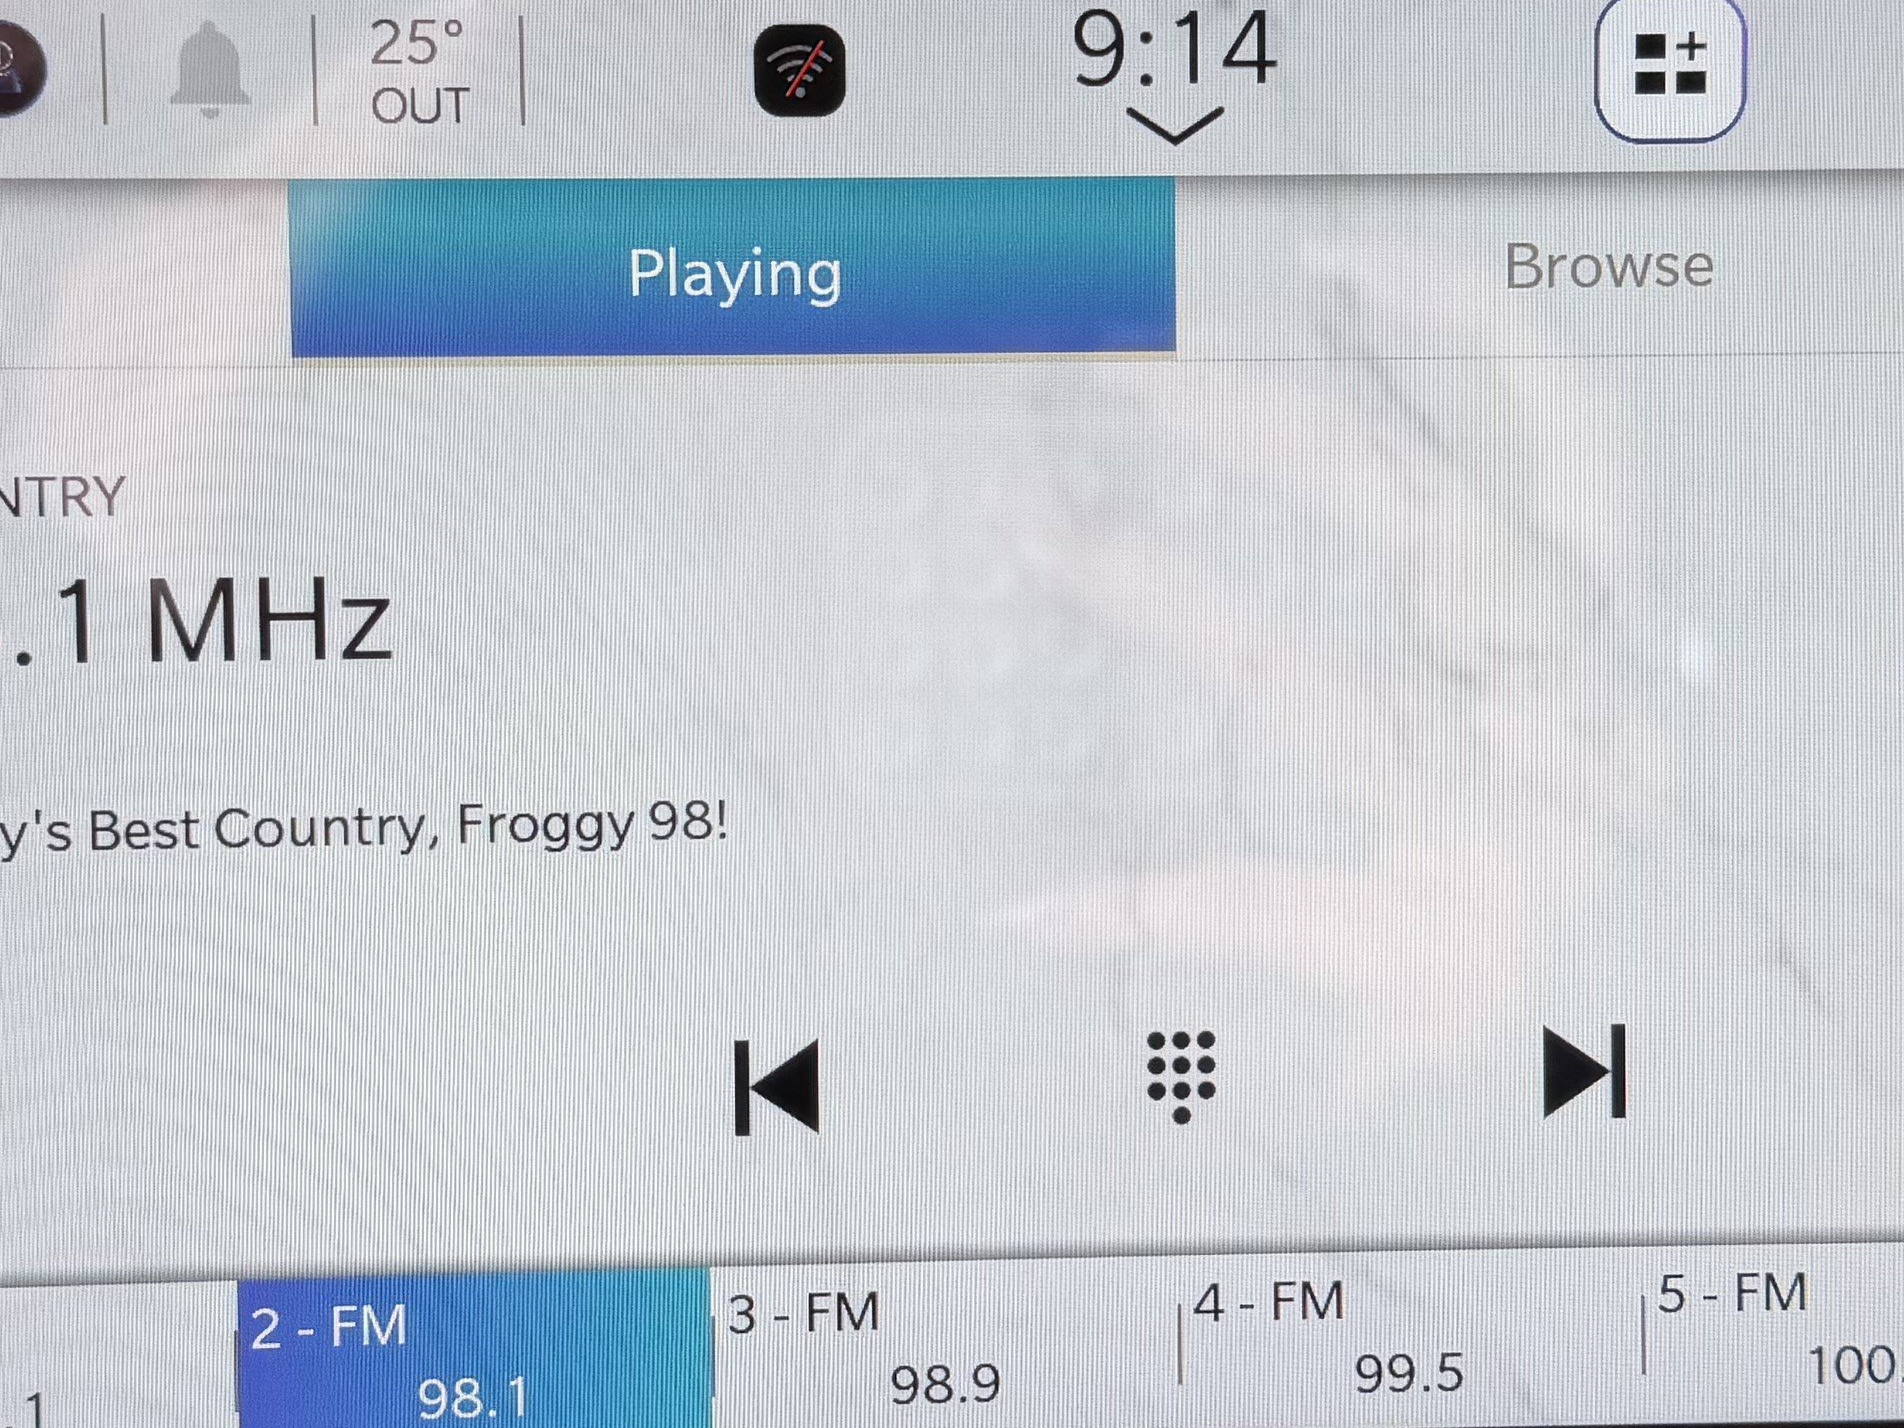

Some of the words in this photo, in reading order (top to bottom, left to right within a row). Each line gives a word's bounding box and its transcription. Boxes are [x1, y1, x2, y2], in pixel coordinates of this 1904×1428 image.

[1072, 7, 1278, 87] 9:14
[371, 86, 470, 125] OUT
[630, 246, 842, 309] Playing
[1506, 240, 1714, 290] Browse
[149, 575, 393, 663] MHz
[89, 808, 200, 852] Best
[214, 805, 440, 854] Country,
[458, 801, 636, 853] Froggy
[648, 798, 729, 842] 98!
[728, 1295, 757, 1335] 3
[807, 1291, 881, 1332] FM
[1193, 1283, 1225, 1323] 4
[1273, 1281, 1345, 1321] FM
[1658, 1273, 1684, 1314] 5
[1736, 1271, 1809, 1311] FM
[251, 1309, 282, 1351] 2
[332, 1304, 409, 1347] FM
[890, 1364, 1002, 1407] 98.9
[1354, 1351, 1466, 1394] 99.5
[416, 1377, 528, 1420] 98.1
